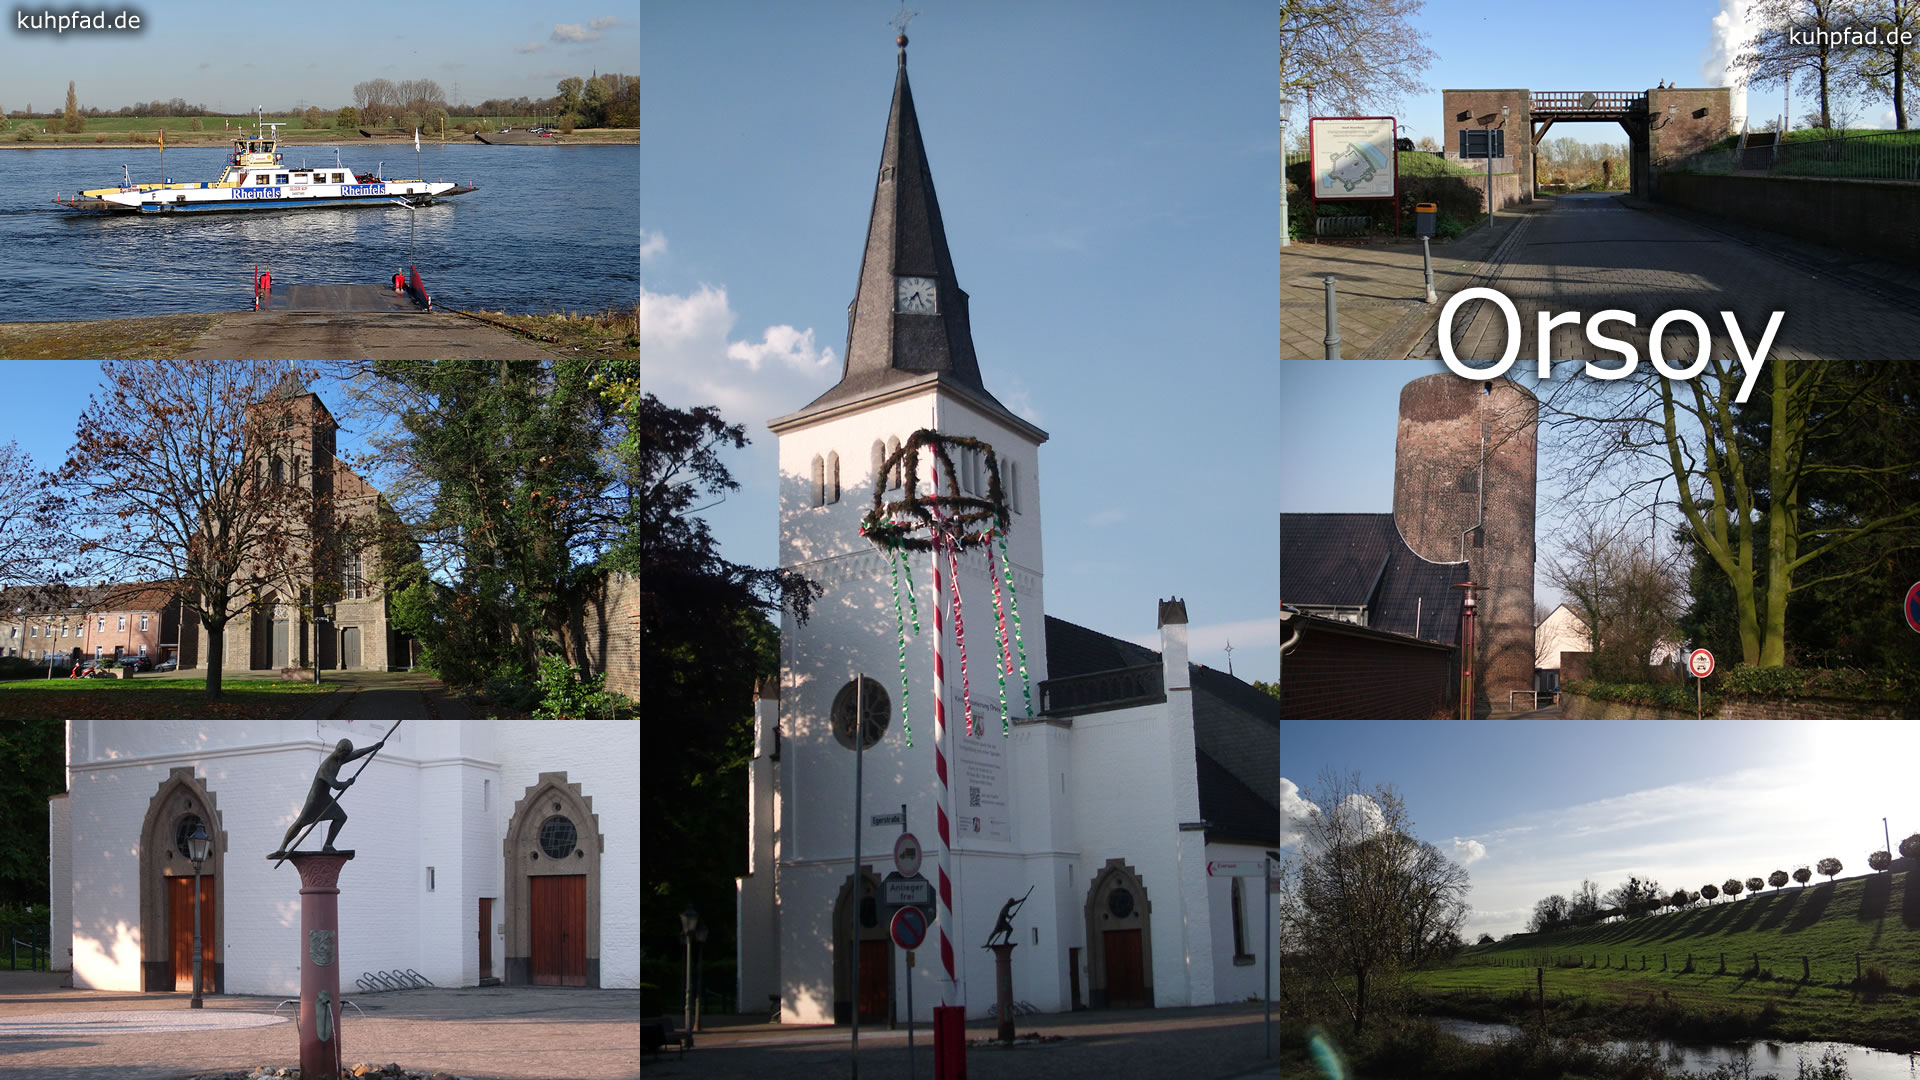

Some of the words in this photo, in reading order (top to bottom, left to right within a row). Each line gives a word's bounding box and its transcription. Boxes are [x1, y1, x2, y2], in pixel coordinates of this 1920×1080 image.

[232, 187, 281, 199] Rheinfels
[341, 184, 386, 196] Rheinfels
[890, 883, 923, 893] Anlieger
[900, 892, 915, 900] frei
